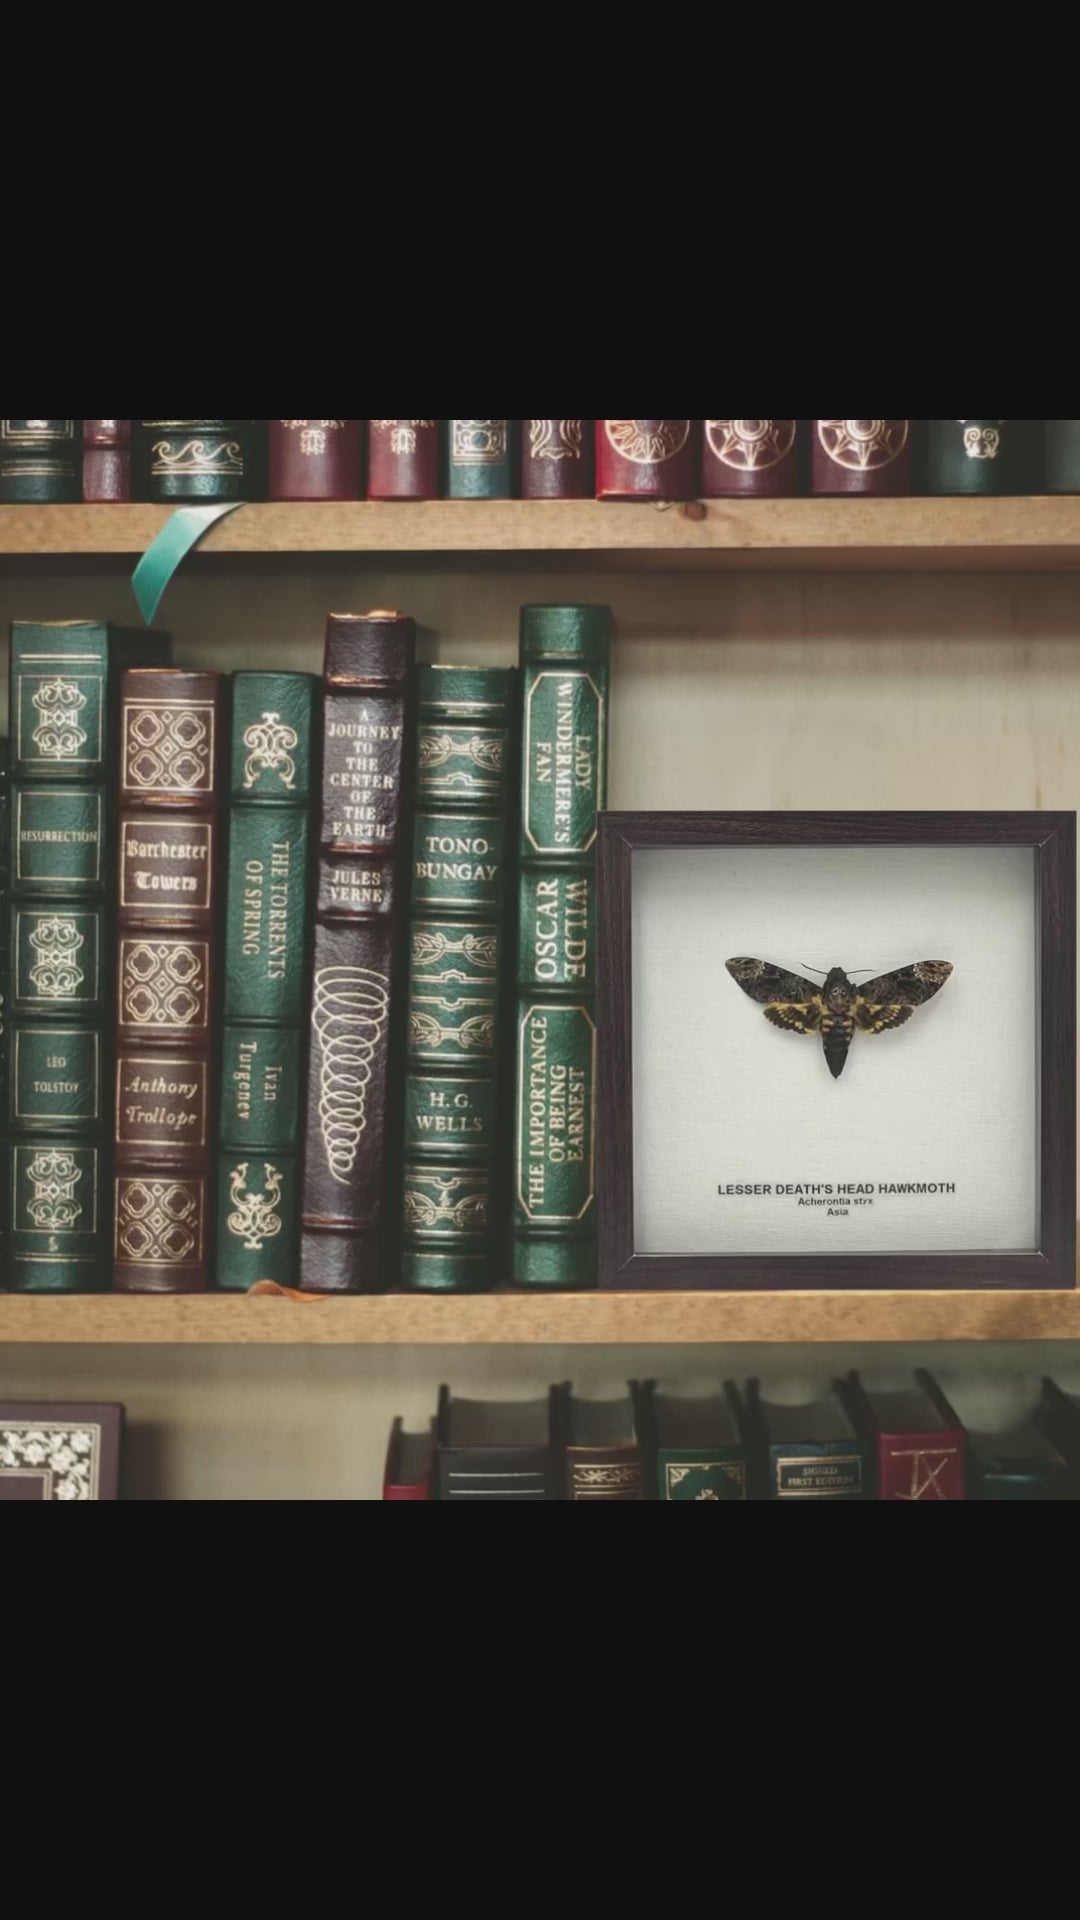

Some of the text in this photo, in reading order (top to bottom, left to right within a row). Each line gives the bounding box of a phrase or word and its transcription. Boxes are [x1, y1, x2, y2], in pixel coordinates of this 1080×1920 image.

[358, 707, 370, 721] A
[328, 723, 400, 740] JOURNEY
[352, 741, 373, 755] TO
[346, 757, 378, 771] THE
[536, 741, 552, 783] FAN
[554, 682, 573, 844] WINDERMERE'S
[575, 735, 593, 791] LADY
[330, 773, 394, 789] CENTER
[350, 790, 372, 804] OF
[343, 806, 376, 821] THE
[20, 830, 98, 842] RESURRECTION
[332, 822, 386, 837] EARTH
[126, 839, 207, 860] Barchester
[332, 870, 381, 885] JULES
[415, 862, 498, 880] BUNGAY
[134, 871, 197, 891] Towers
[330, 886, 383, 903] VERNE
[242, 860, 264, 955] OF SPRING
[268, 841, 289, 979] THE TORRENTS
[534, 879, 558, 979] OSCAR
[564, 880, 588, 978] WILDE
[47, 1056, 66, 1068] LEO
[33, 1082, 79, 1093] TOLSTOY
[125, 1076, 197, 1099] Anthony
[233, 1041, 257, 1120] Turgenev
[263, 1065, 282, 1101] Ivan
[126, 1105, 197, 1130] Trollope
[529, 1016, 548, 1208] THE IMPORTANCE
[549, 1064, 567, 1162] OF BEING
[568, 1066, 585, 1161] EARNEST
[416, 1115, 483, 1132] WELLS
[718, 1183, 956, 1195] LESSER DEATH'S HEAD HAWKMOTH
[798, 1197, 851, 1206] Acherontia
[827, 1208, 848, 1216] Asia
